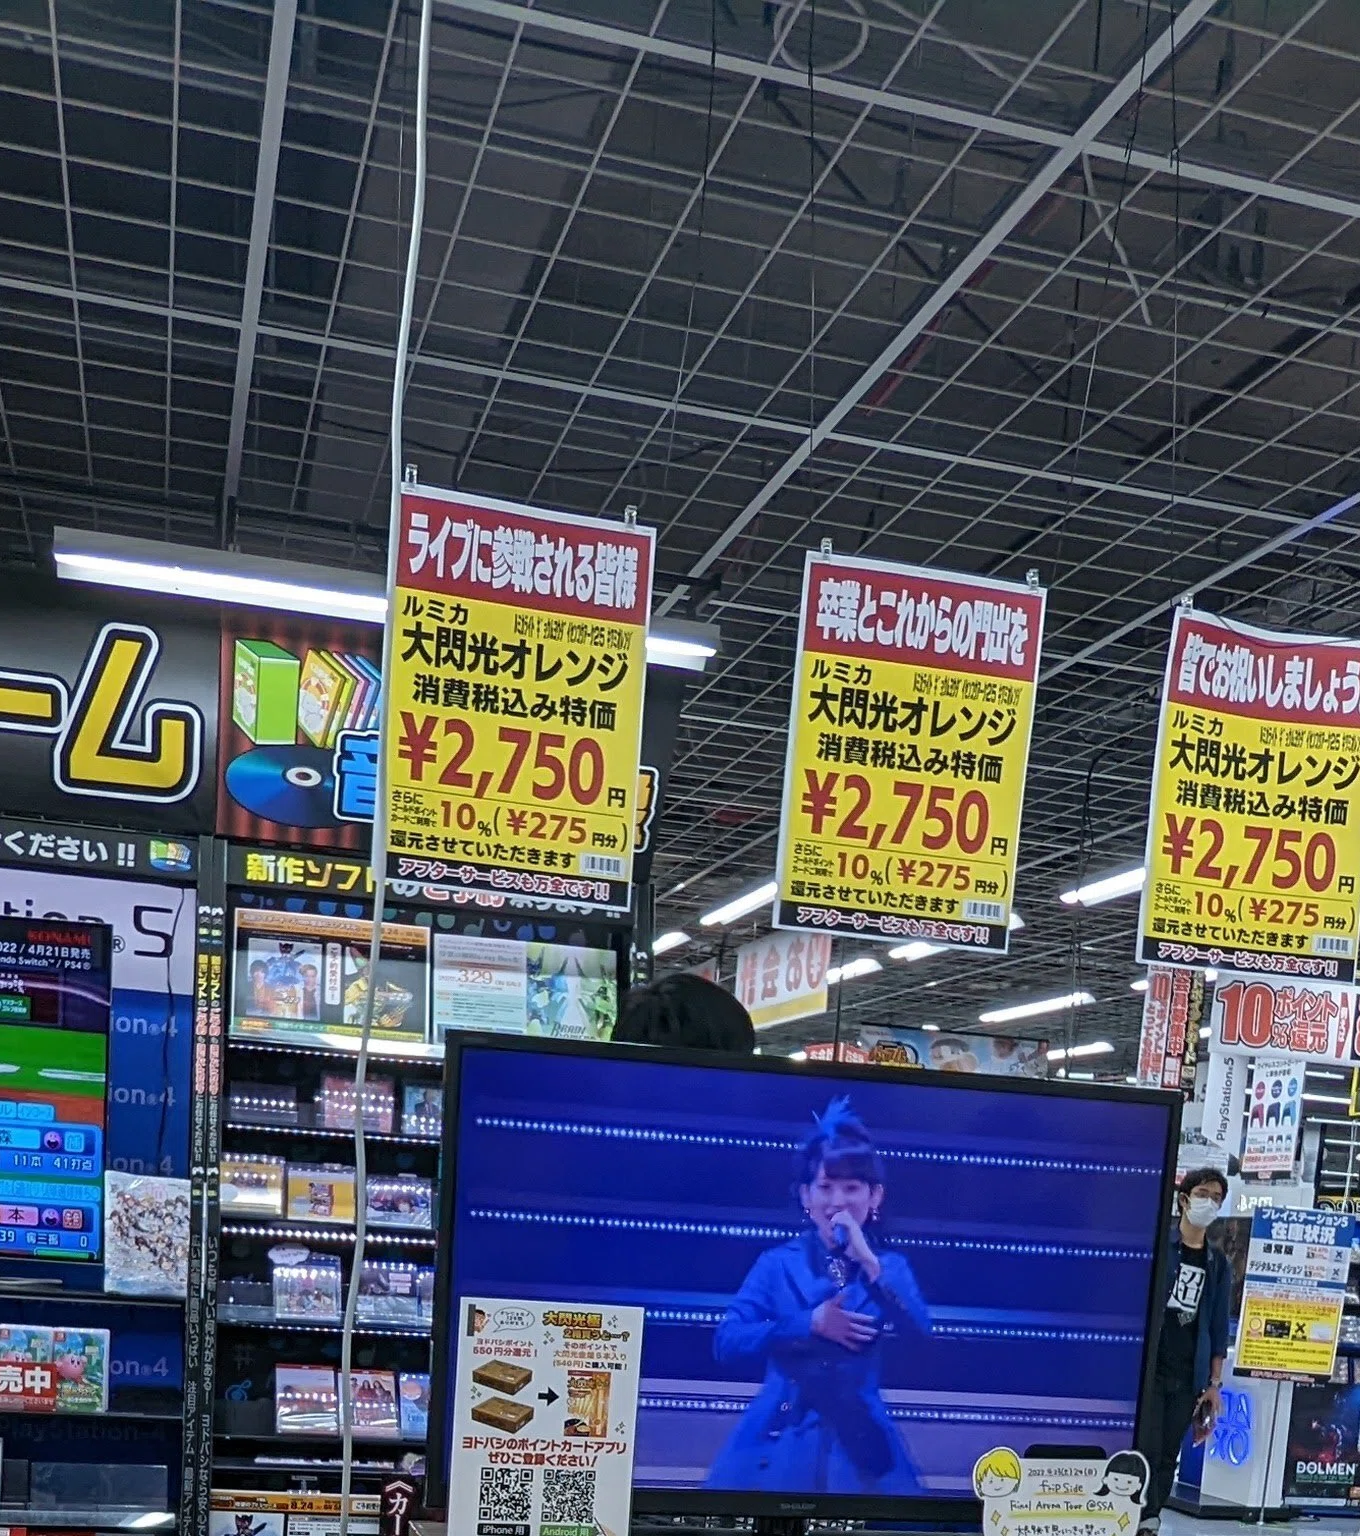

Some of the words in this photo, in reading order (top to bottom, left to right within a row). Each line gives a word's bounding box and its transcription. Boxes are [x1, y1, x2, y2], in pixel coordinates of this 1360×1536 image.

[408, 512, 639, 609] ライブに参戦される皆様
[402, 595, 469, 626] ルミカ
[817, 577, 1029, 665] 卒業とこれからの門出を
[401, 621, 629, 692] 大閃光オレンジ
[810, 659, 872, 685] ルミカ
[413, 673, 616, 731] 消費税込み特価
[808, 688, 1017, 746] 大閃光オレンジ
[1172, 710, 1224, 736] ルミカ
[817, 732, 1003, 783] 消費税込み特価
[1170, 737, 1360, 791] 大閃光オレンジ
[392, 790, 422, 805] さらに
[1176, 779, 1348, 826] 消費税込み特価
[391, 829, 576, 869] 還元させていただきます
[790, 879, 959, 914] 還元させていただきます
[463, 1436, 627, 1455] ヨドバシのポイントカードアプリ
[1296, 1461, 1356, 1476] DOLMEN
[482, 1525, 513, 1534] iPhone
[542, 1526, 577, 1536] Android
